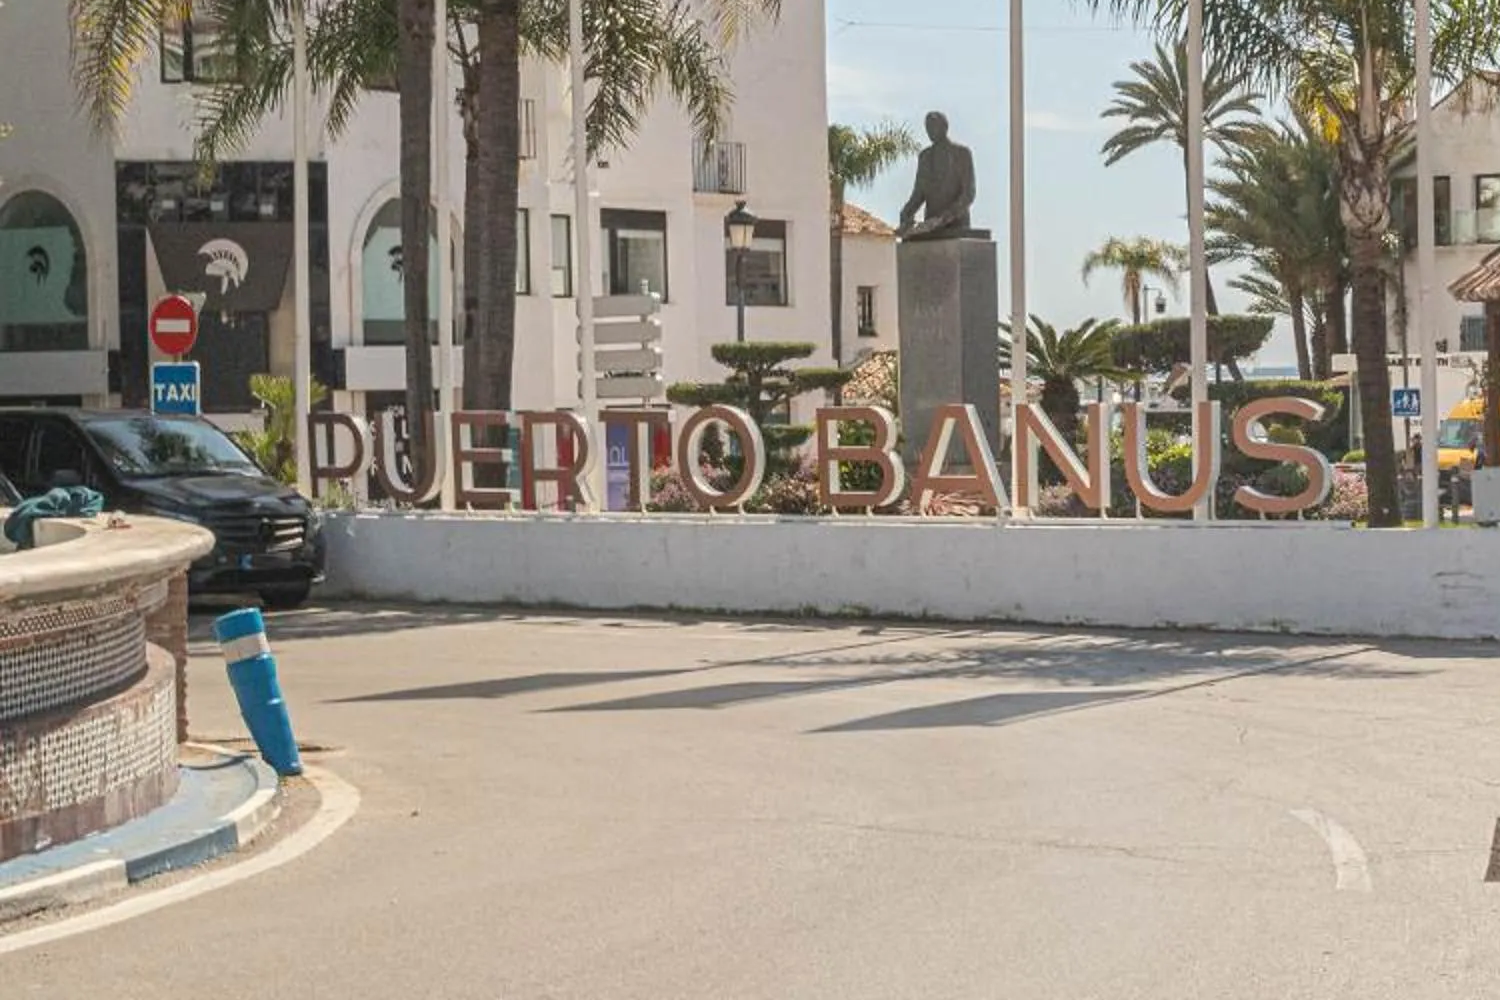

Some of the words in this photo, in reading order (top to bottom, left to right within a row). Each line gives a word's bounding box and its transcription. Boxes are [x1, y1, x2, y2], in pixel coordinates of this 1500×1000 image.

[154, 383, 196, 402] TAXI
[307, 404, 766, 508] PUERTO
[815, 397, 1332, 512] BANUS
